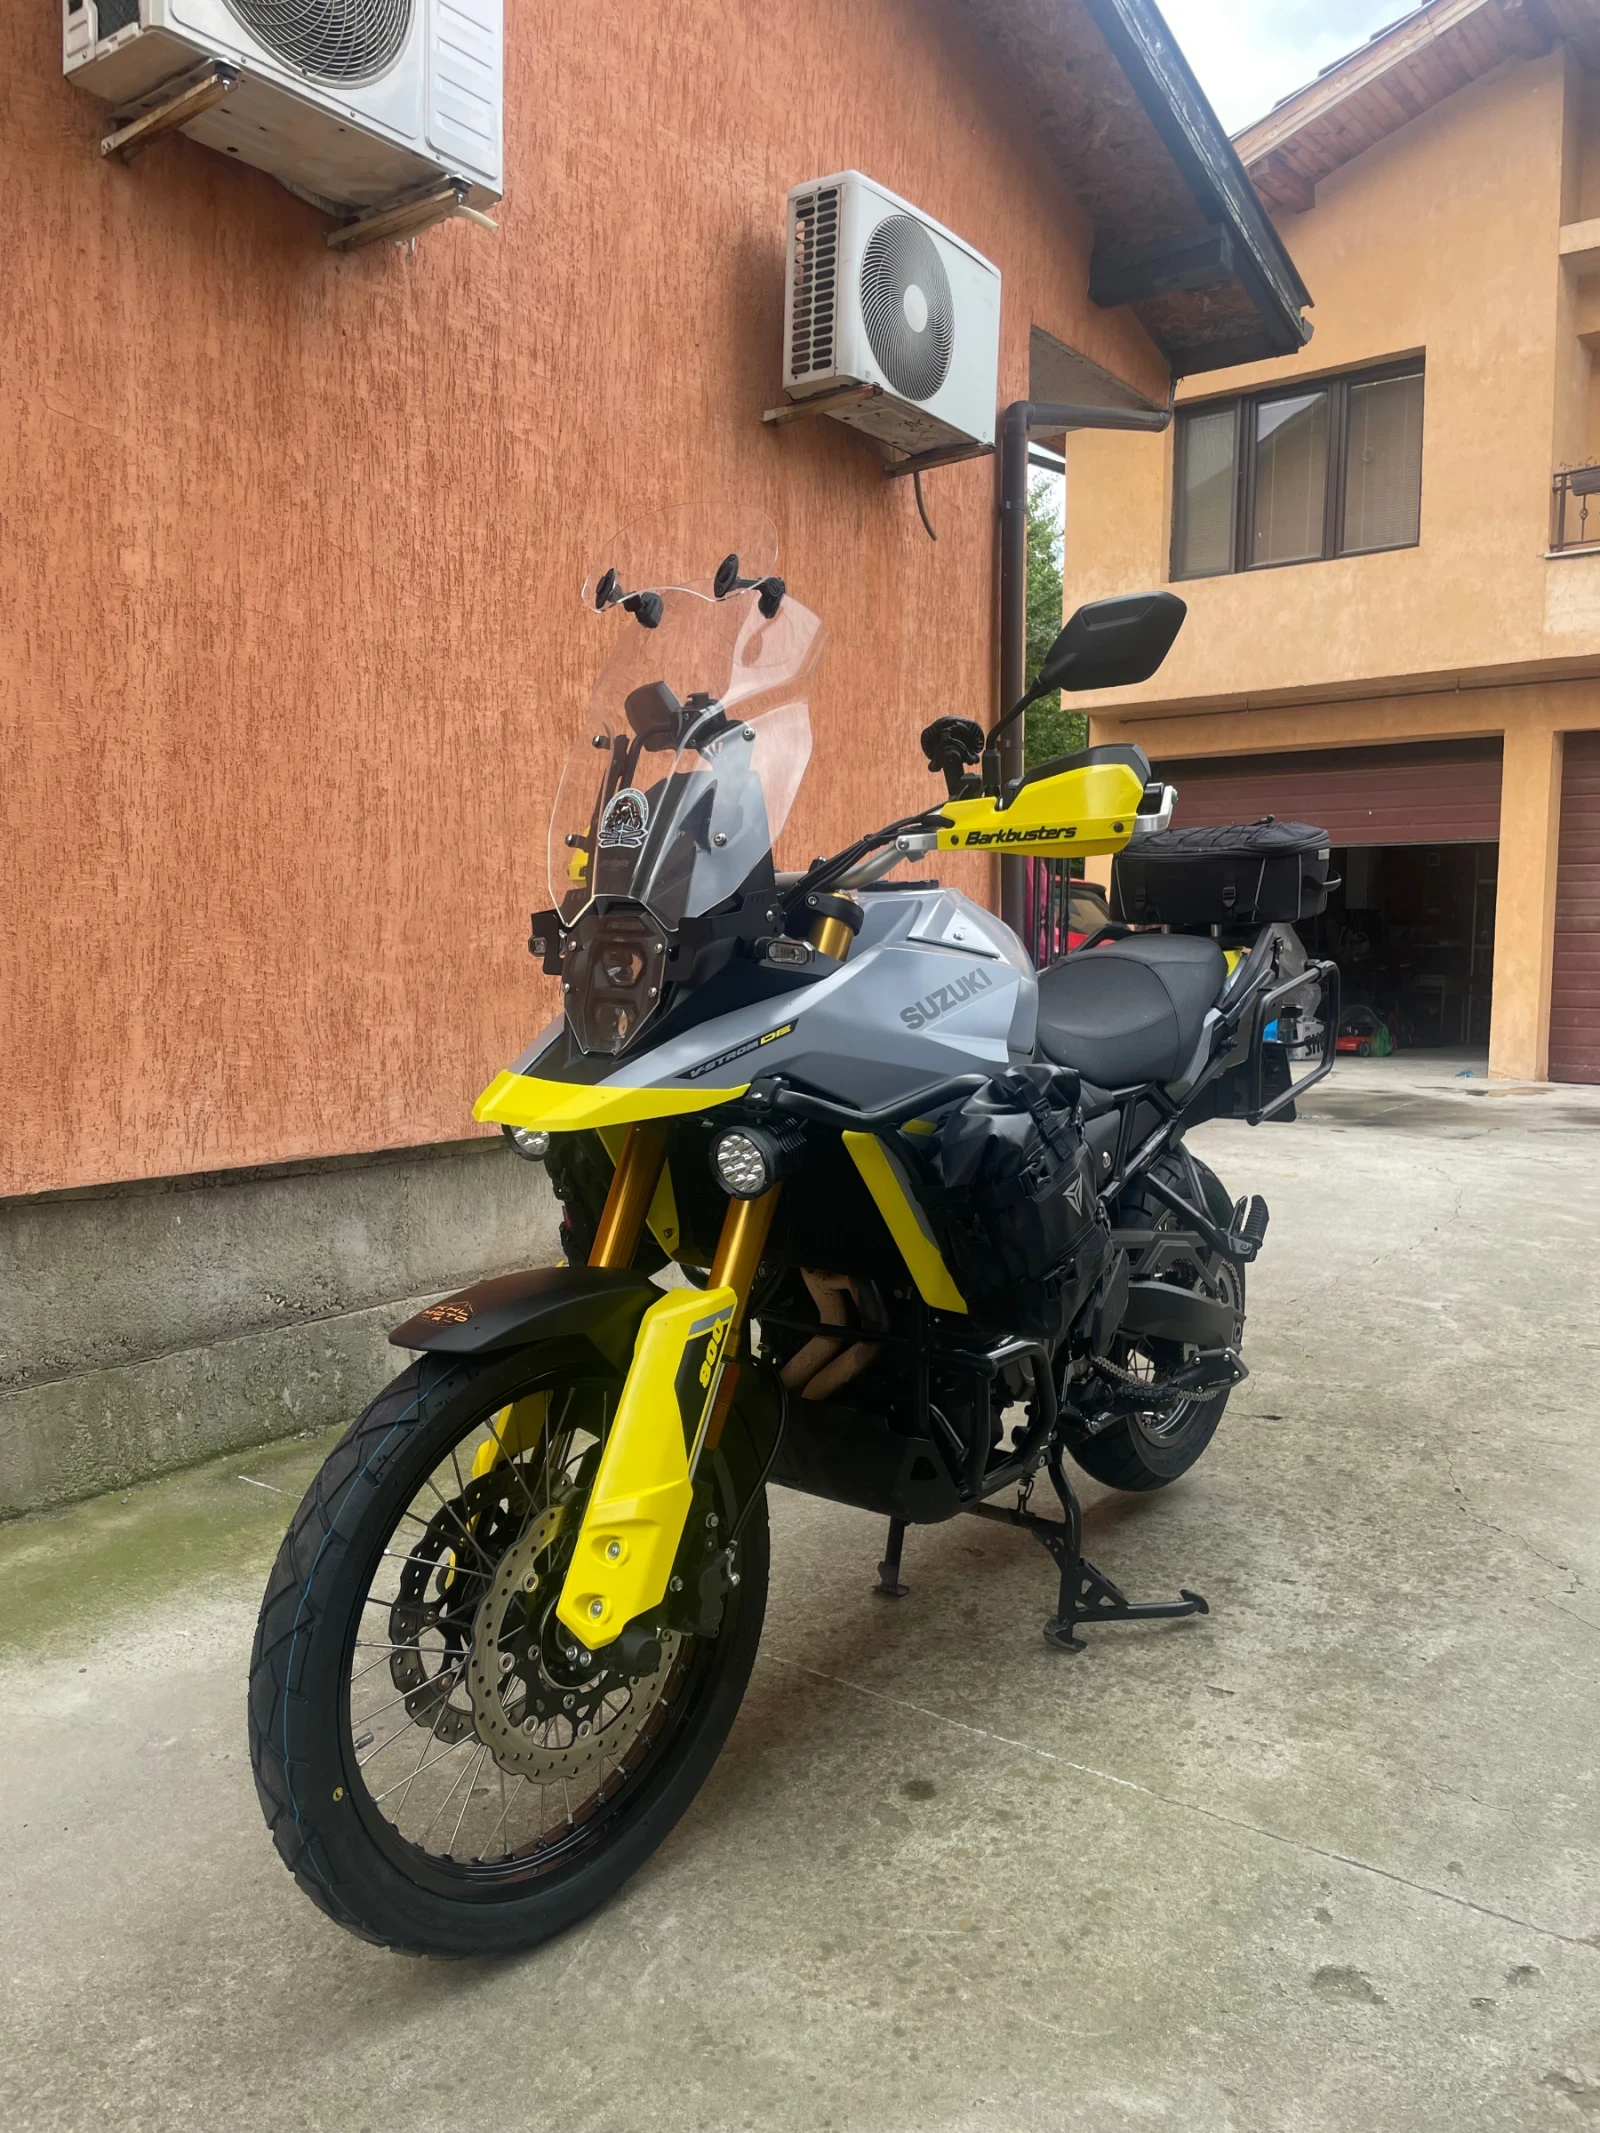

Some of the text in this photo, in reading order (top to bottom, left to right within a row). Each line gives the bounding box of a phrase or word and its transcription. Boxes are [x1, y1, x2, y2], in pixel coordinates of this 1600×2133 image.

[965, 825, 1077, 846] Barkbusters
[900, 967, 993, 1030] SUZUKI
[690, 1024, 791, 1078] V-STROM DE
[699, 1317, 724, 1389] 800
